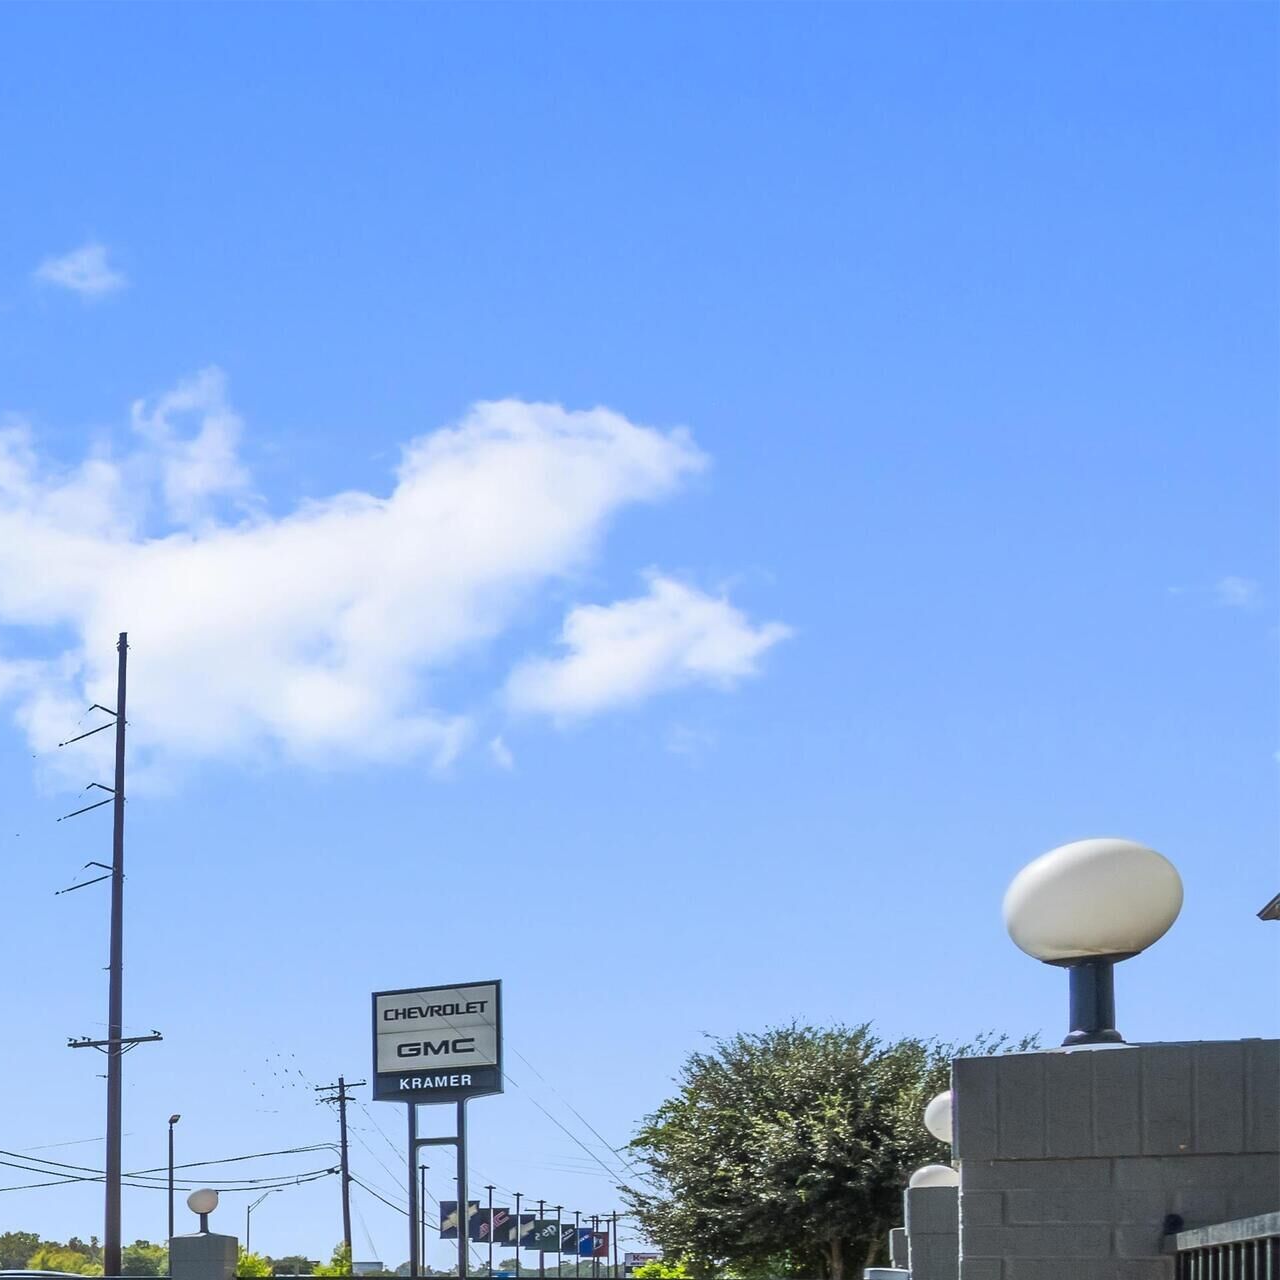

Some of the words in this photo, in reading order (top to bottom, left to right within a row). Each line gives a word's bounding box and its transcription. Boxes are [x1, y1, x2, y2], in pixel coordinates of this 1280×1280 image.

[383, 1001, 488, 1021] CHEVROLET
[397, 1038, 475, 1058] GMC
[399, 1074, 472, 1090] KRAMER
